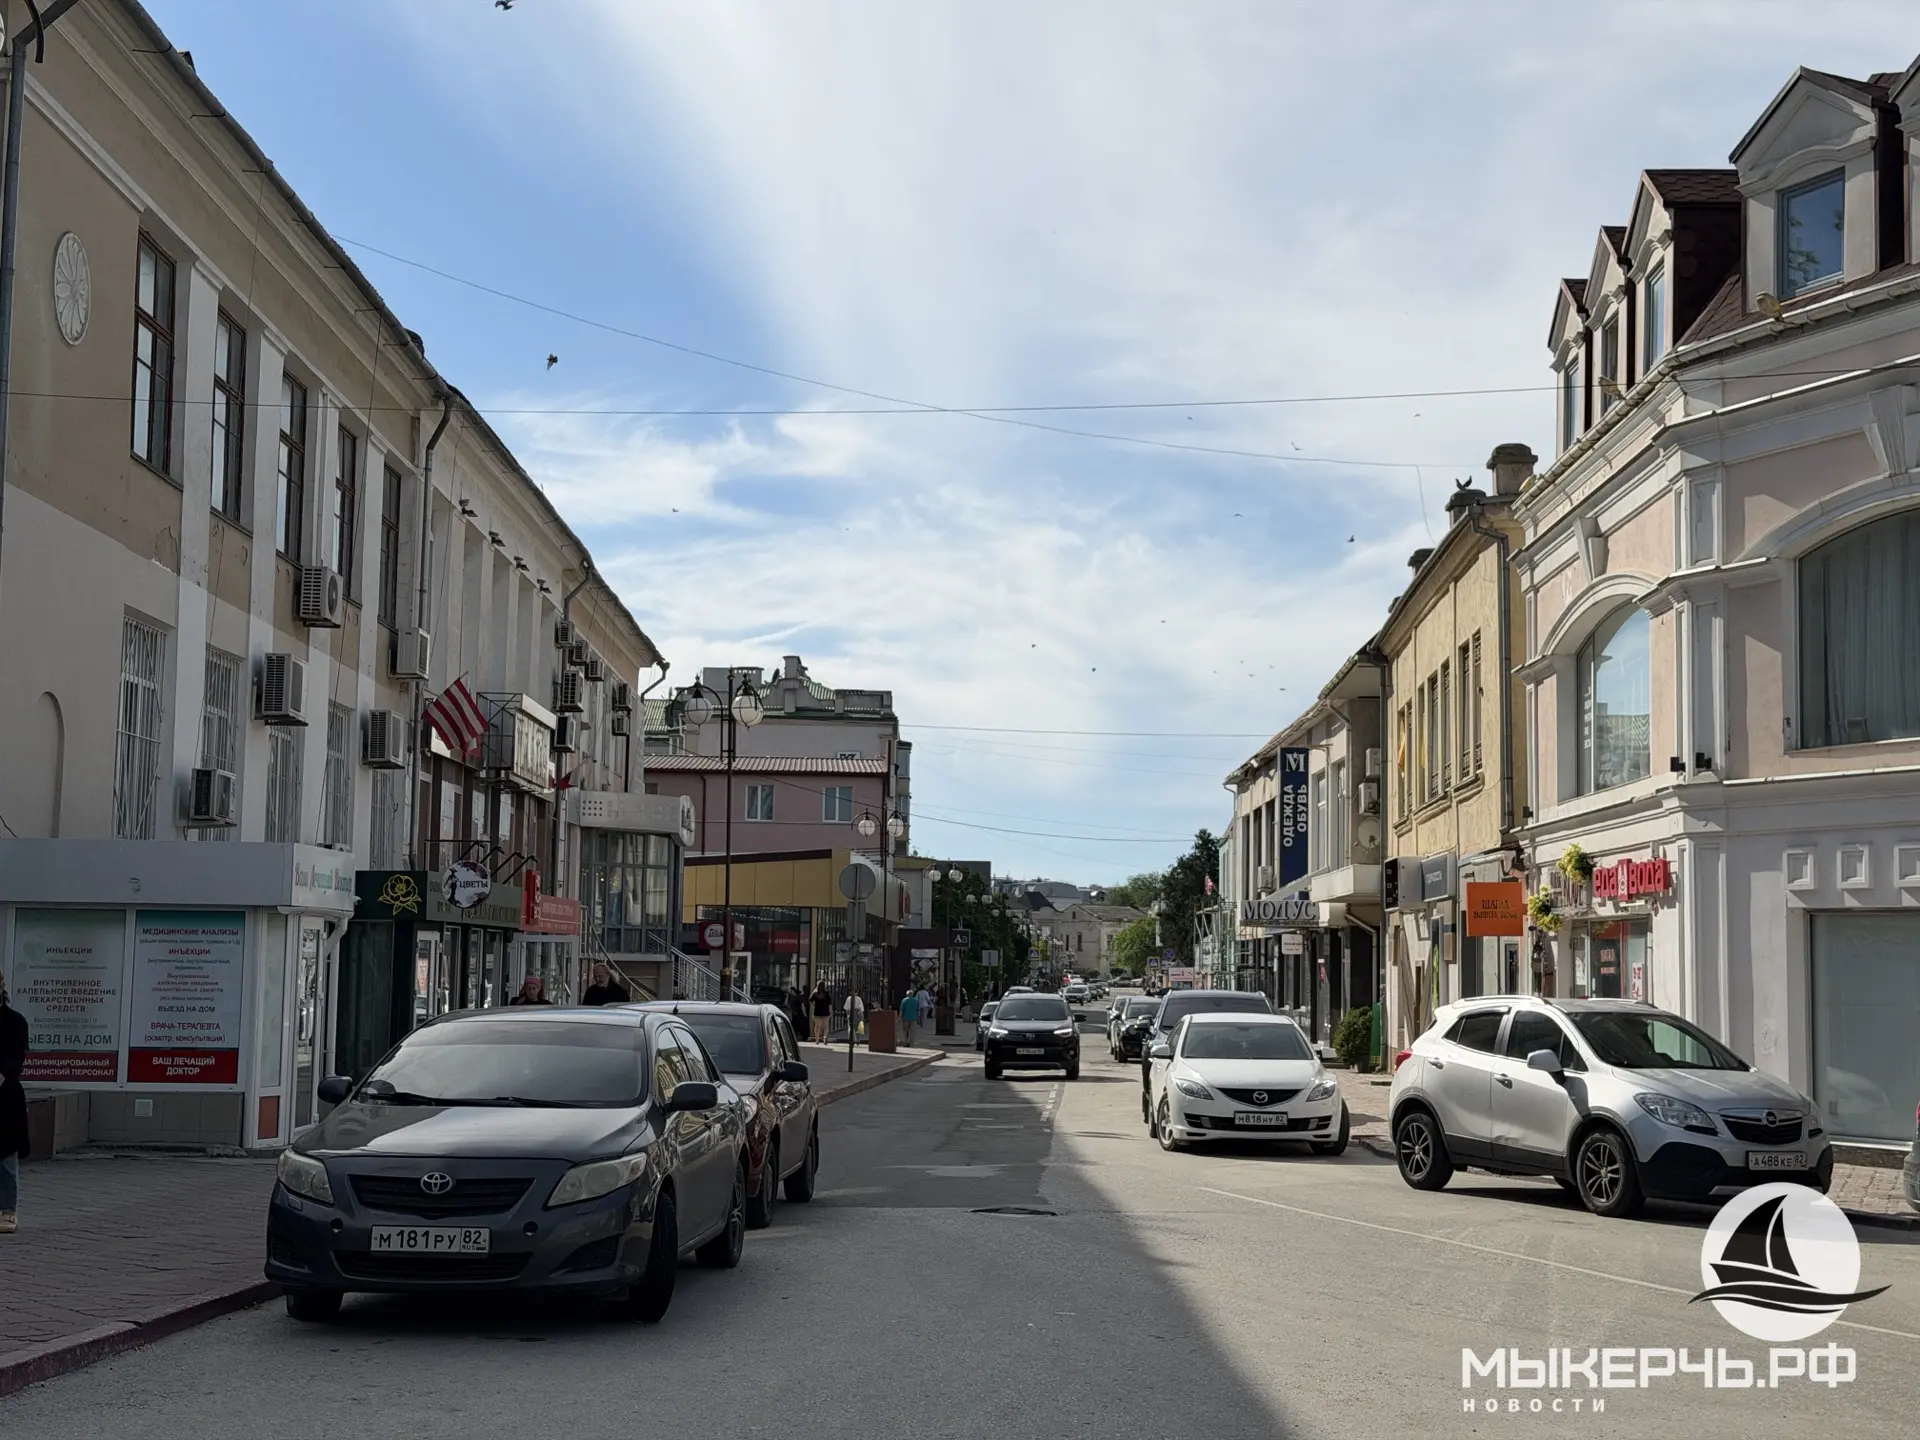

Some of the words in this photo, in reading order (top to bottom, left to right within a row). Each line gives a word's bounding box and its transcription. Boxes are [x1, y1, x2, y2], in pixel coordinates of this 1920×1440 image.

[1297, 784, 1307, 832] ОБУВЬ
[1283, 784, 1295, 847] ОДЕЖДА
[459, 880, 488, 889] ЦВЕТЫ
[1243, 901, 1317, 920] МОДУС
[142, 928, 199, 936] МЕДИЦИНСКИЕ
[201, 928, 239, 936] АНАЛИЗЫ
[46, 947, 92, 955] ИНЪЕКЦИИ
[71, 988, 117, 996] ВВЕДЕНИЕ
[150, 1022, 221, 1030] ВРАЧА-ТЕРАПЕВТА
[28, 1034, 61, 1044] ЫЕЗД
[65, 1034, 80, 1044] НА
[84, 1035, 112, 1045] ДОМ
[152, 1057, 172, 1065] ВАШ
[173, 1056, 216, 1065] ЛЕЧАЩИЙ
[72, 1068, 114, 1076] ПЕРСОНАЛ
[166, 1067, 200, 1076] ДОКТОР
[462, 1230, 482, 1244] 82
